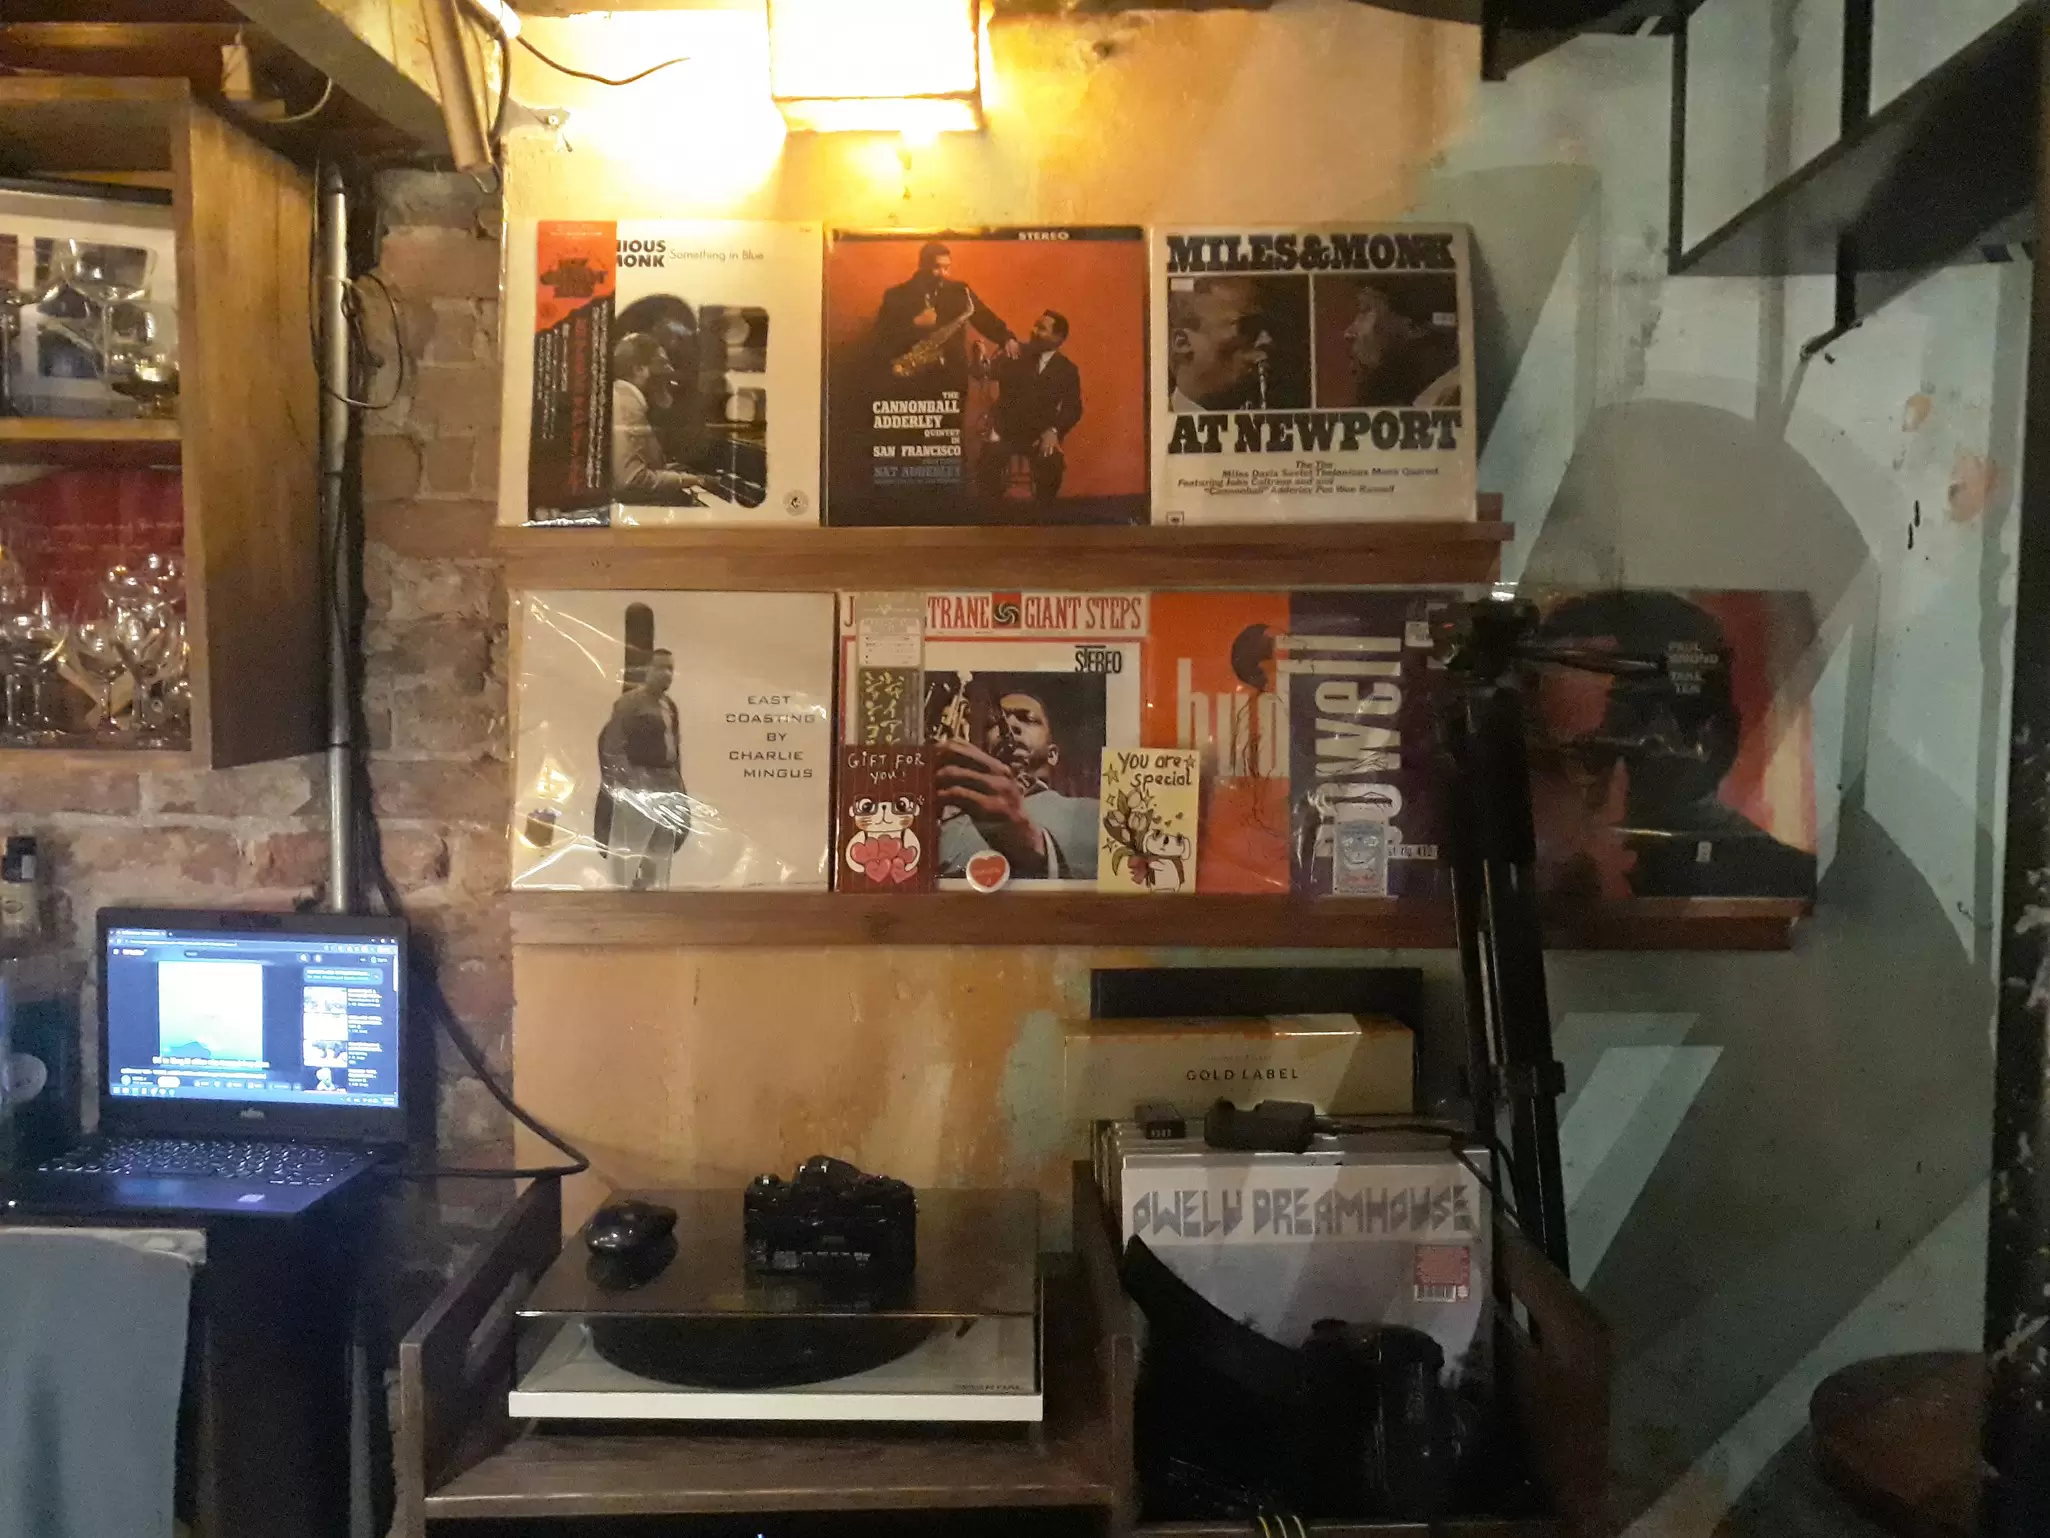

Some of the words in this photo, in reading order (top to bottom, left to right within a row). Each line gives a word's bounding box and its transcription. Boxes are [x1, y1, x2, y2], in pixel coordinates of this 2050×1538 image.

[1018, 231, 1069, 241] STEREO
[669, 249, 726, 263] Something
[742, 249, 764, 261] Blue
[872, 400, 960, 414] CANNONBALL
[873, 414, 943, 429] ADDERLEY
[1168, 414, 1228, 454] AT
[1234, 411, 1462, 453] NEWPORT
[873, 445, 896, 457] SAN
[901, 445, 961, 457] FRANCISCO
[1222, 469, 1250, 478] Miles
[925, 595, 990, 629] TRANE
[1021, 597, 1083, 629] GIANT
[1086, 596, 1142, 629] STEPS
[1074, 644, 1123, 675] STEREO
[747, 695, 791, 705] EAST
[724, 713, 816, 724] COASTING
[766, 732, 788, 741] BY
[729, 751, 804, 761] CHARLIE
[895, 752, 926, 770] FOR
[1155, 755, 1182, 769] are
[743, 768, 813, 779] MINGUS
[1130, 767, 1192, 792] special
[1186, 1068, 1235, 1082] GOLD
[1241, 1067, 1300, 1081] LABEL
[1253, 1185, 1473, 1238] DREAMHOUSE
